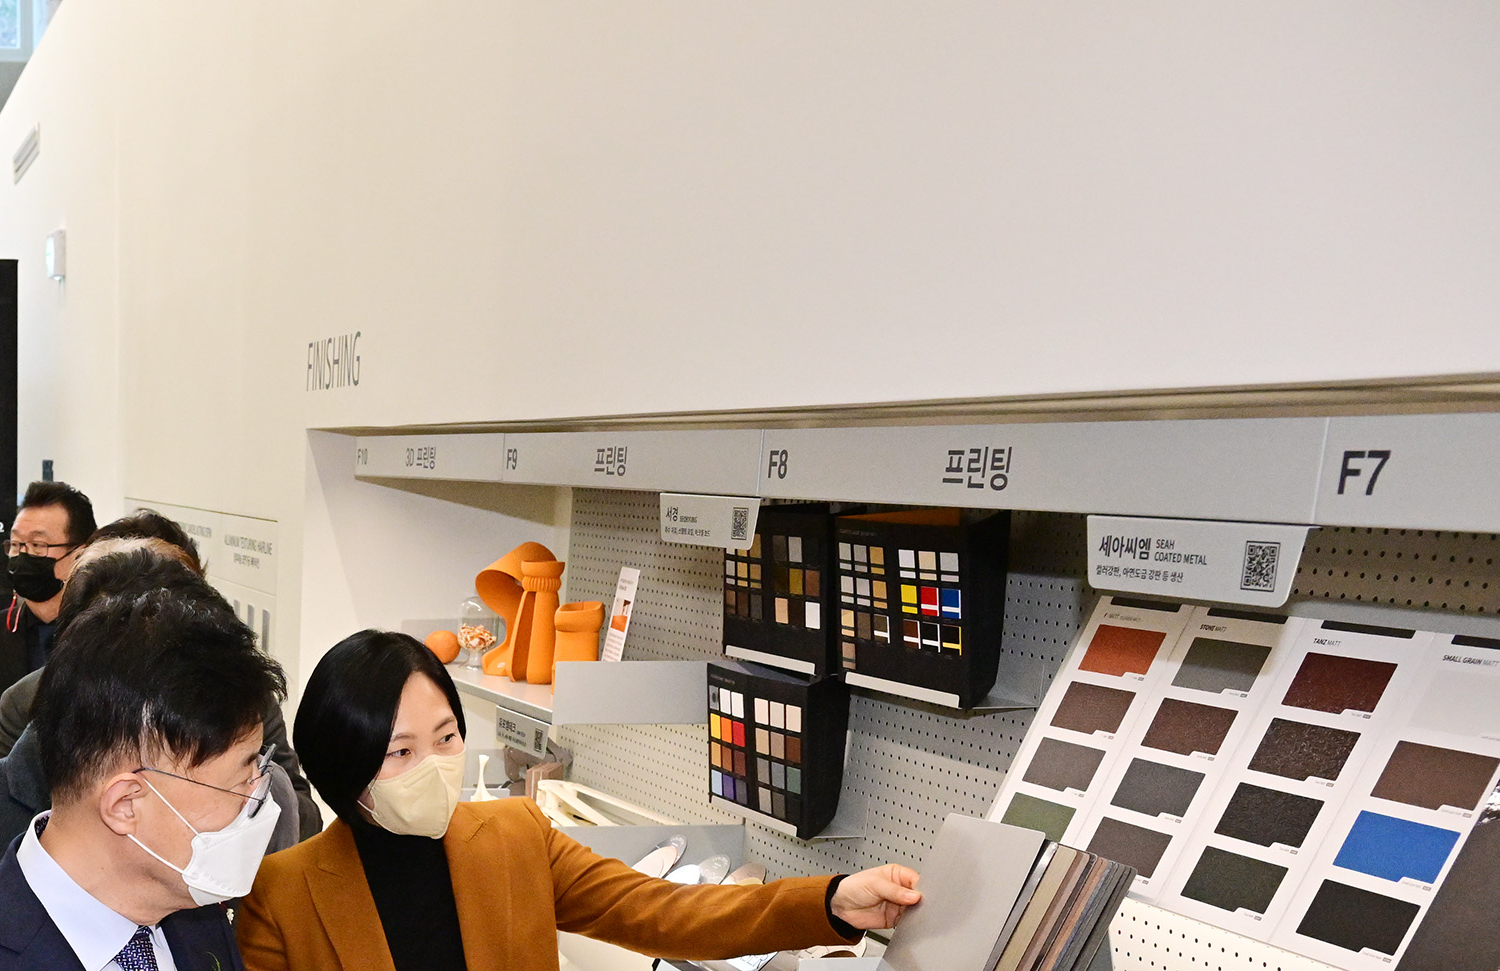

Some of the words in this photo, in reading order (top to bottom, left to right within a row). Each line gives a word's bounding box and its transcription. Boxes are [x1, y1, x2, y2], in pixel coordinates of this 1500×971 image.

[306, 331, 361, 392] FINISHING
[357, 448, 368, 465] F10
[405, 448, 414, 467] 3D
[416, 446, 436, 470] 프린팅
[506, 448, 518, 470] F9
[594, 446, 628, 477] 프린팅
[767, 449, 789, 480] F8
[942, 446, 1013, 491] 프린팅
[1337, 450, 1391, 496] F7
[666, 506, 678, 522] 서경
[1098, 535, 1151, 560] 세아씨엠
[1156, 539, 1175, 550] SEAH
[1154, 551, 1182, 564] COATED
[1183, 553, 1208, 566] METAL
[1096, 564, 1121, 578] 컬러강판,
[1122, 567, 1148, 580] 아연도금
[1148, 569, 1161, 581] 강판
[1162, 571, 1169, 582] 등
[1170, 571, 1184, 583] 생산
[1199, 624, 1216, 632] STONE
[1312, 637, 1328, 646] TANZ
[1327, 639, 1342, 647] MATT
[1442, 654, 1462, 663] SMALL
[1462, 656, 1482, 666] GRAIN
[1481, 659, 1500, 668] MATT
